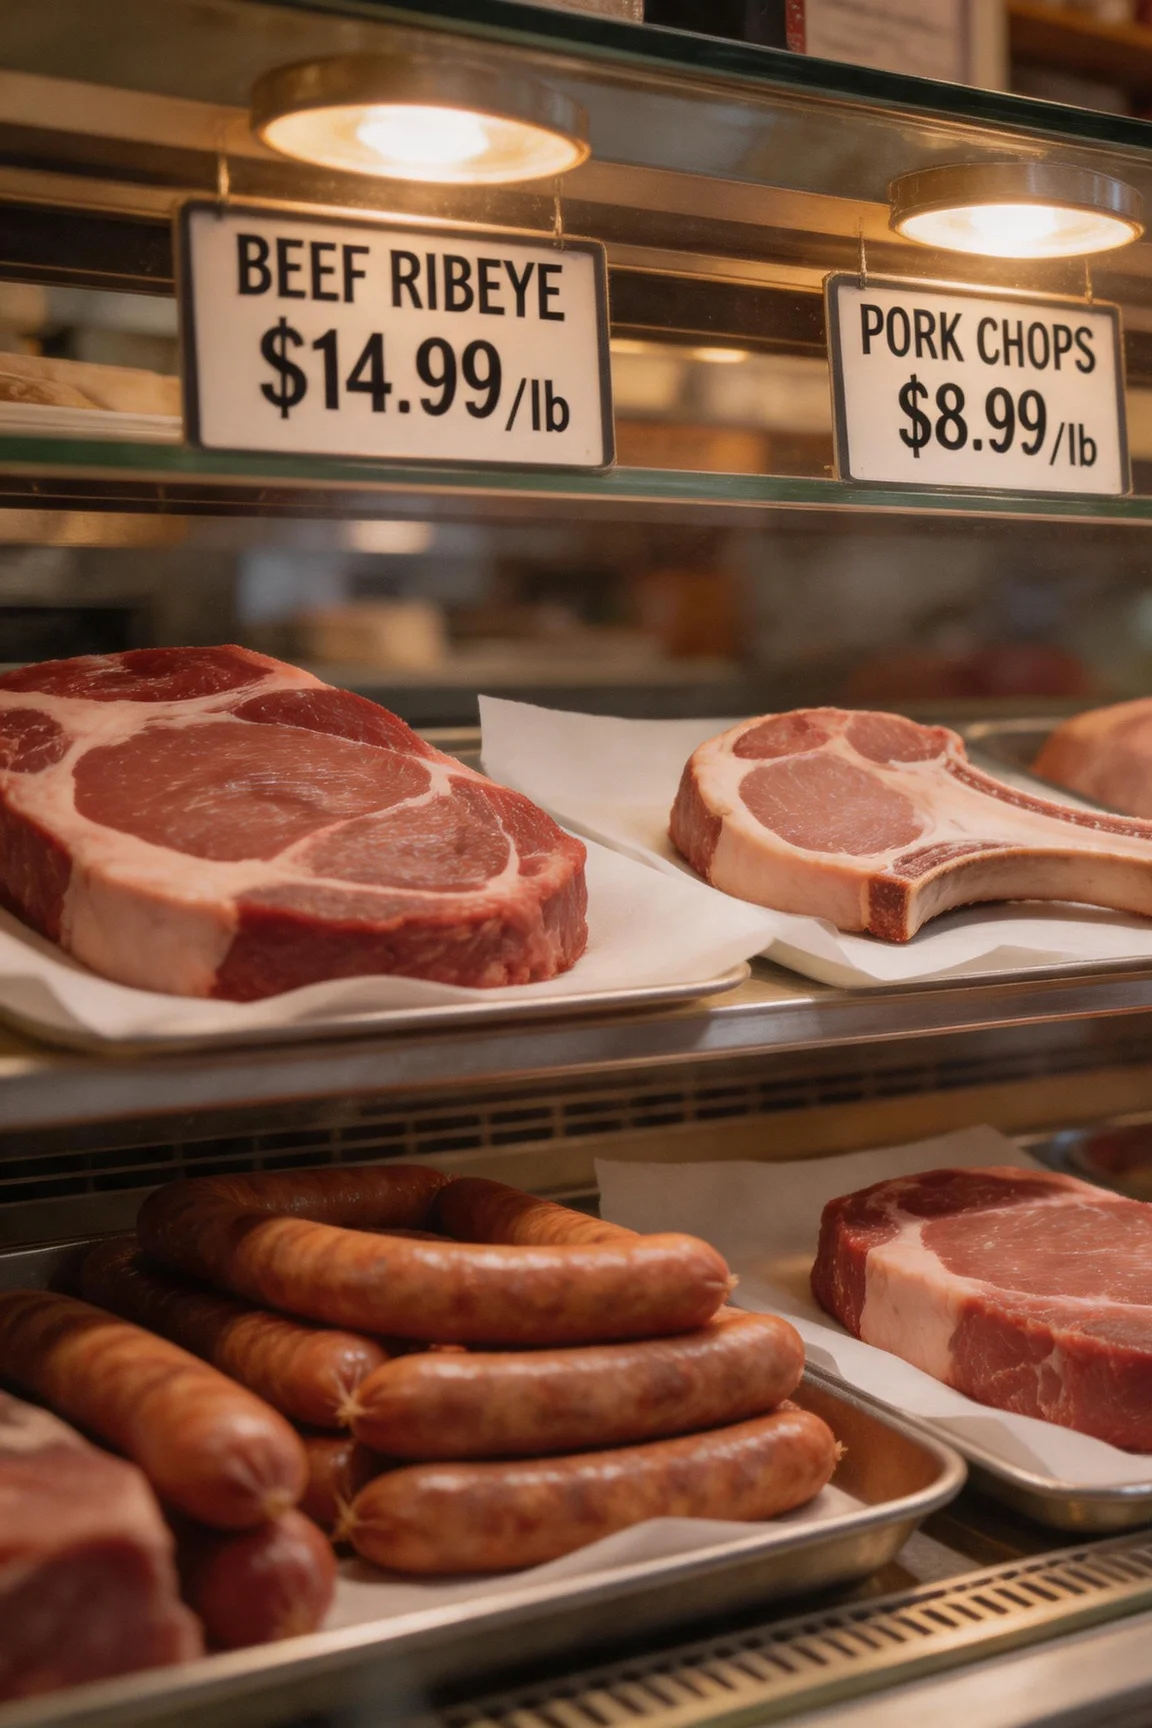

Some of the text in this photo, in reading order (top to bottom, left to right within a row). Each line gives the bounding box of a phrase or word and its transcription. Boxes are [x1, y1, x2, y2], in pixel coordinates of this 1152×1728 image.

[236, 233, 566, 321] BEEF RIBEYE
[260, 316, 570, 433] $14.99/lb
[860, 303, 1096, 374] PORK CHOPS
[898, 373, 1098, 468] $8.99/lb
